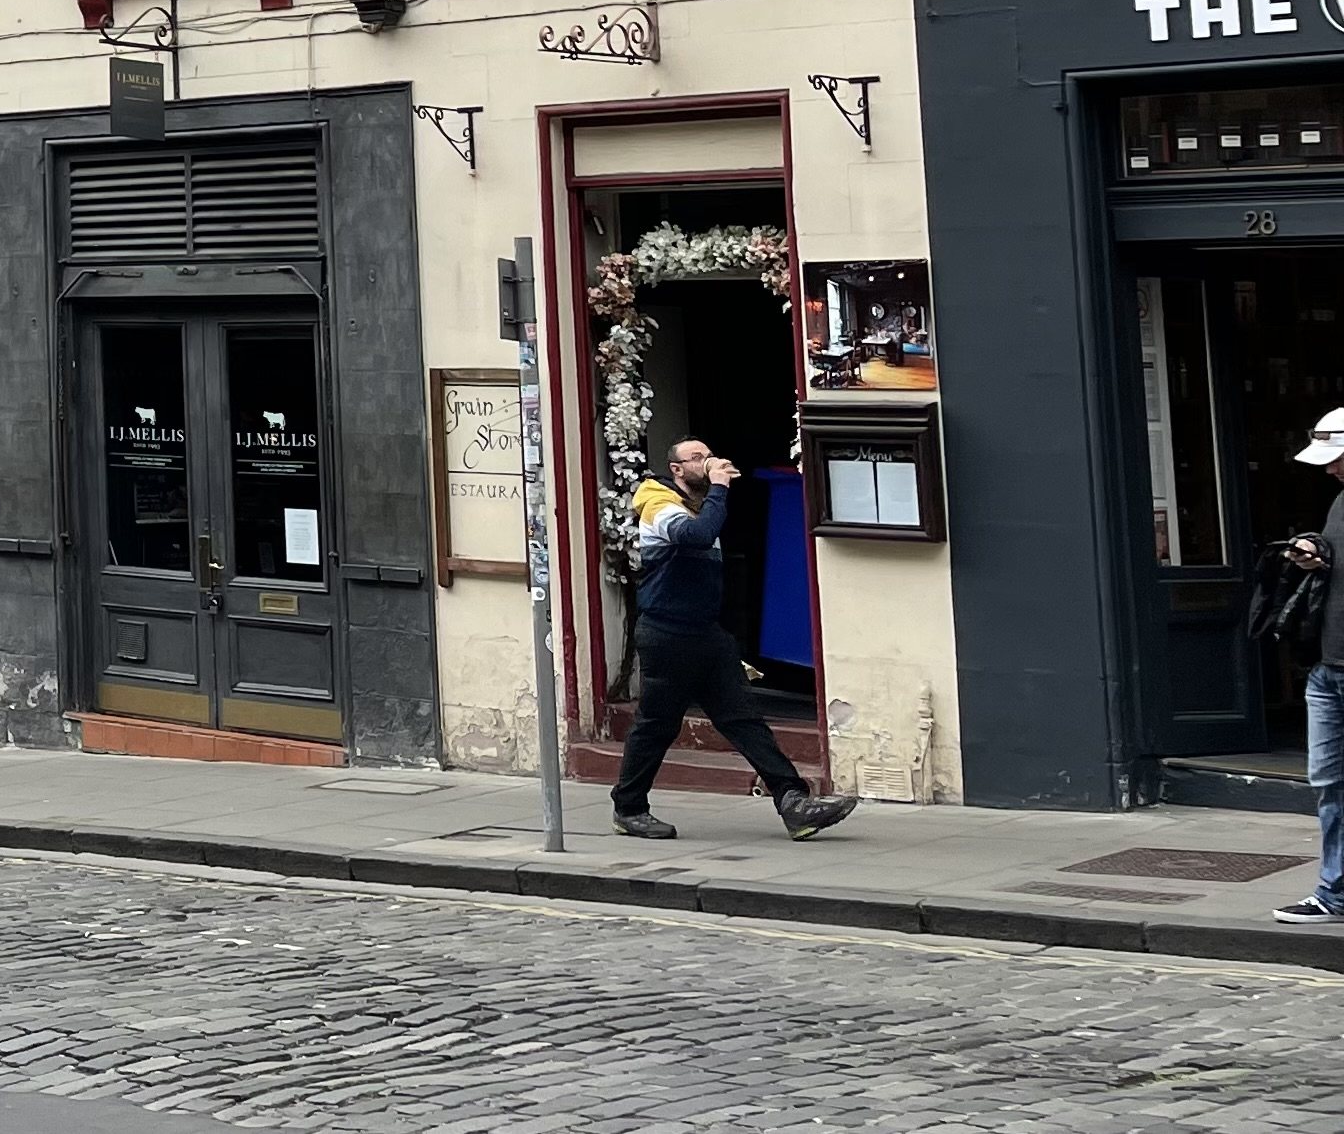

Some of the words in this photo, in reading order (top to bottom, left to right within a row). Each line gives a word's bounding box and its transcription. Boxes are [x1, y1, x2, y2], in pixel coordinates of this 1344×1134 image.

[1244, 210, 1277, 236] 28
[445, 390, 494, 435] Grain
[109, 426, 185, 443] I.J.MELLIS
[236, 432, 317, 447] I.J.MELLIS
[854, 445, 893, 462] Menu
[450, 483, 522, 499] ESTAURA
